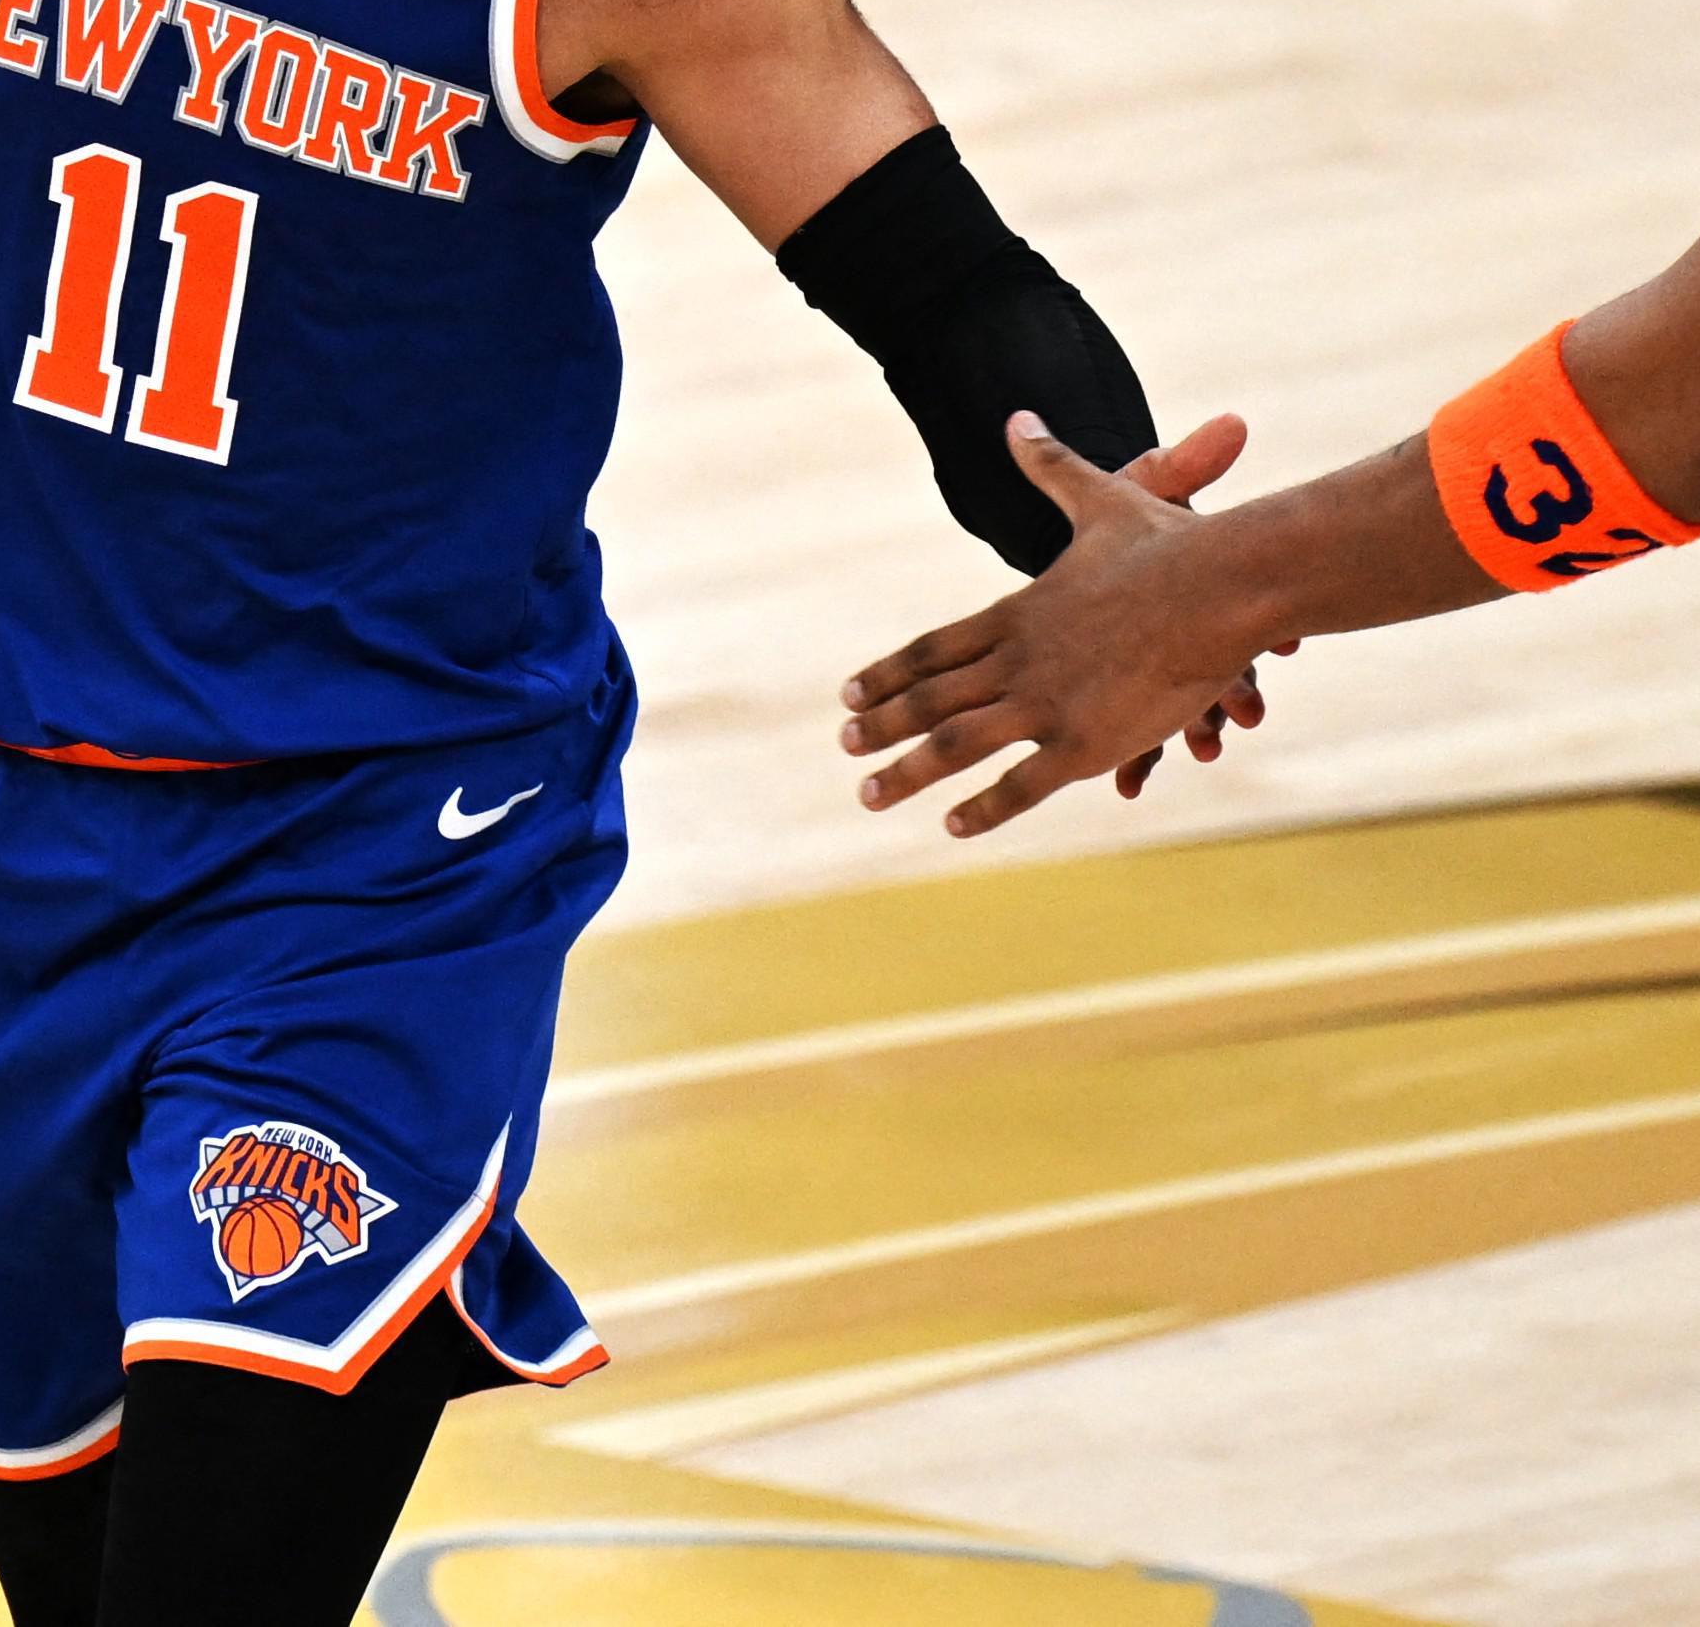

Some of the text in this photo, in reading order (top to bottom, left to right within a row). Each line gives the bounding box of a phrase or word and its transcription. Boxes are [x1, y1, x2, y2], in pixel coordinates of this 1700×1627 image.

[13, 142, 259, 467] 11
[192, 1131, 362, 1246] KNICKS
[260, 1127, 333, 1162] NEW YORK
